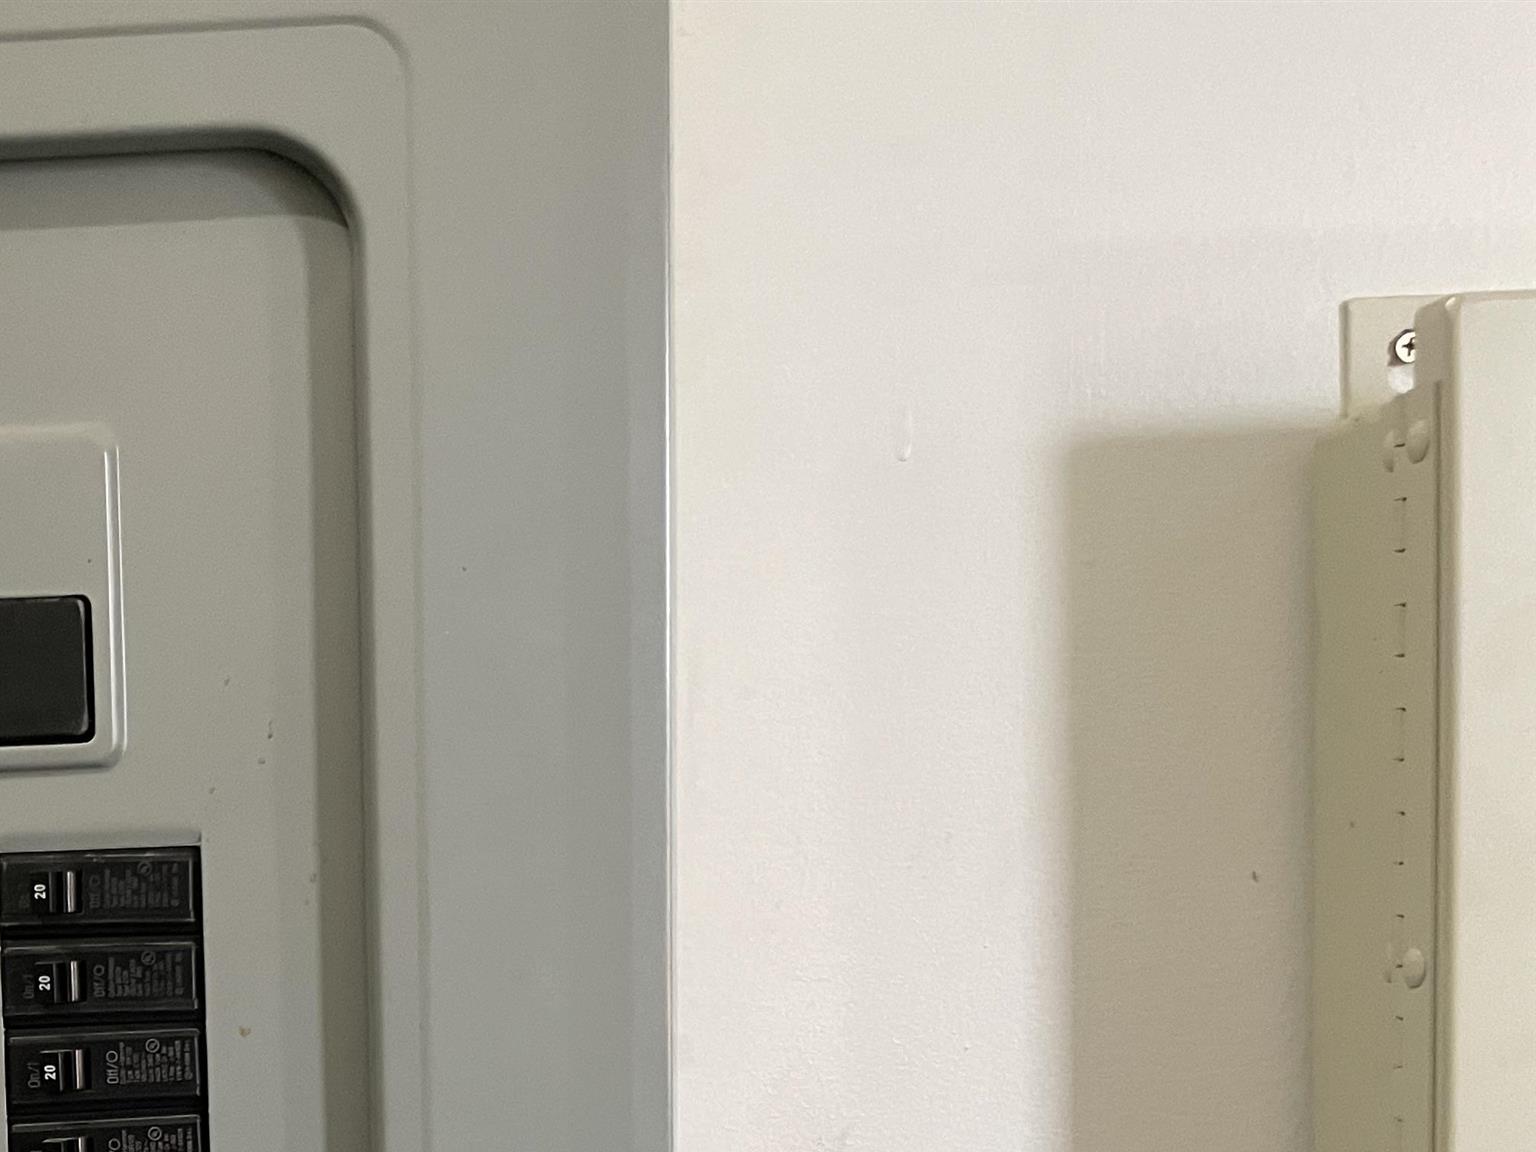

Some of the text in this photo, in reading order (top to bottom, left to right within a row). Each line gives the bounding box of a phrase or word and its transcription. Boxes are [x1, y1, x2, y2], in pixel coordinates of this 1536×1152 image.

[34, 885, 45, 899] 20
[39, 976, 50, 990] 20
[44, 1065, 55, 1079] 20
